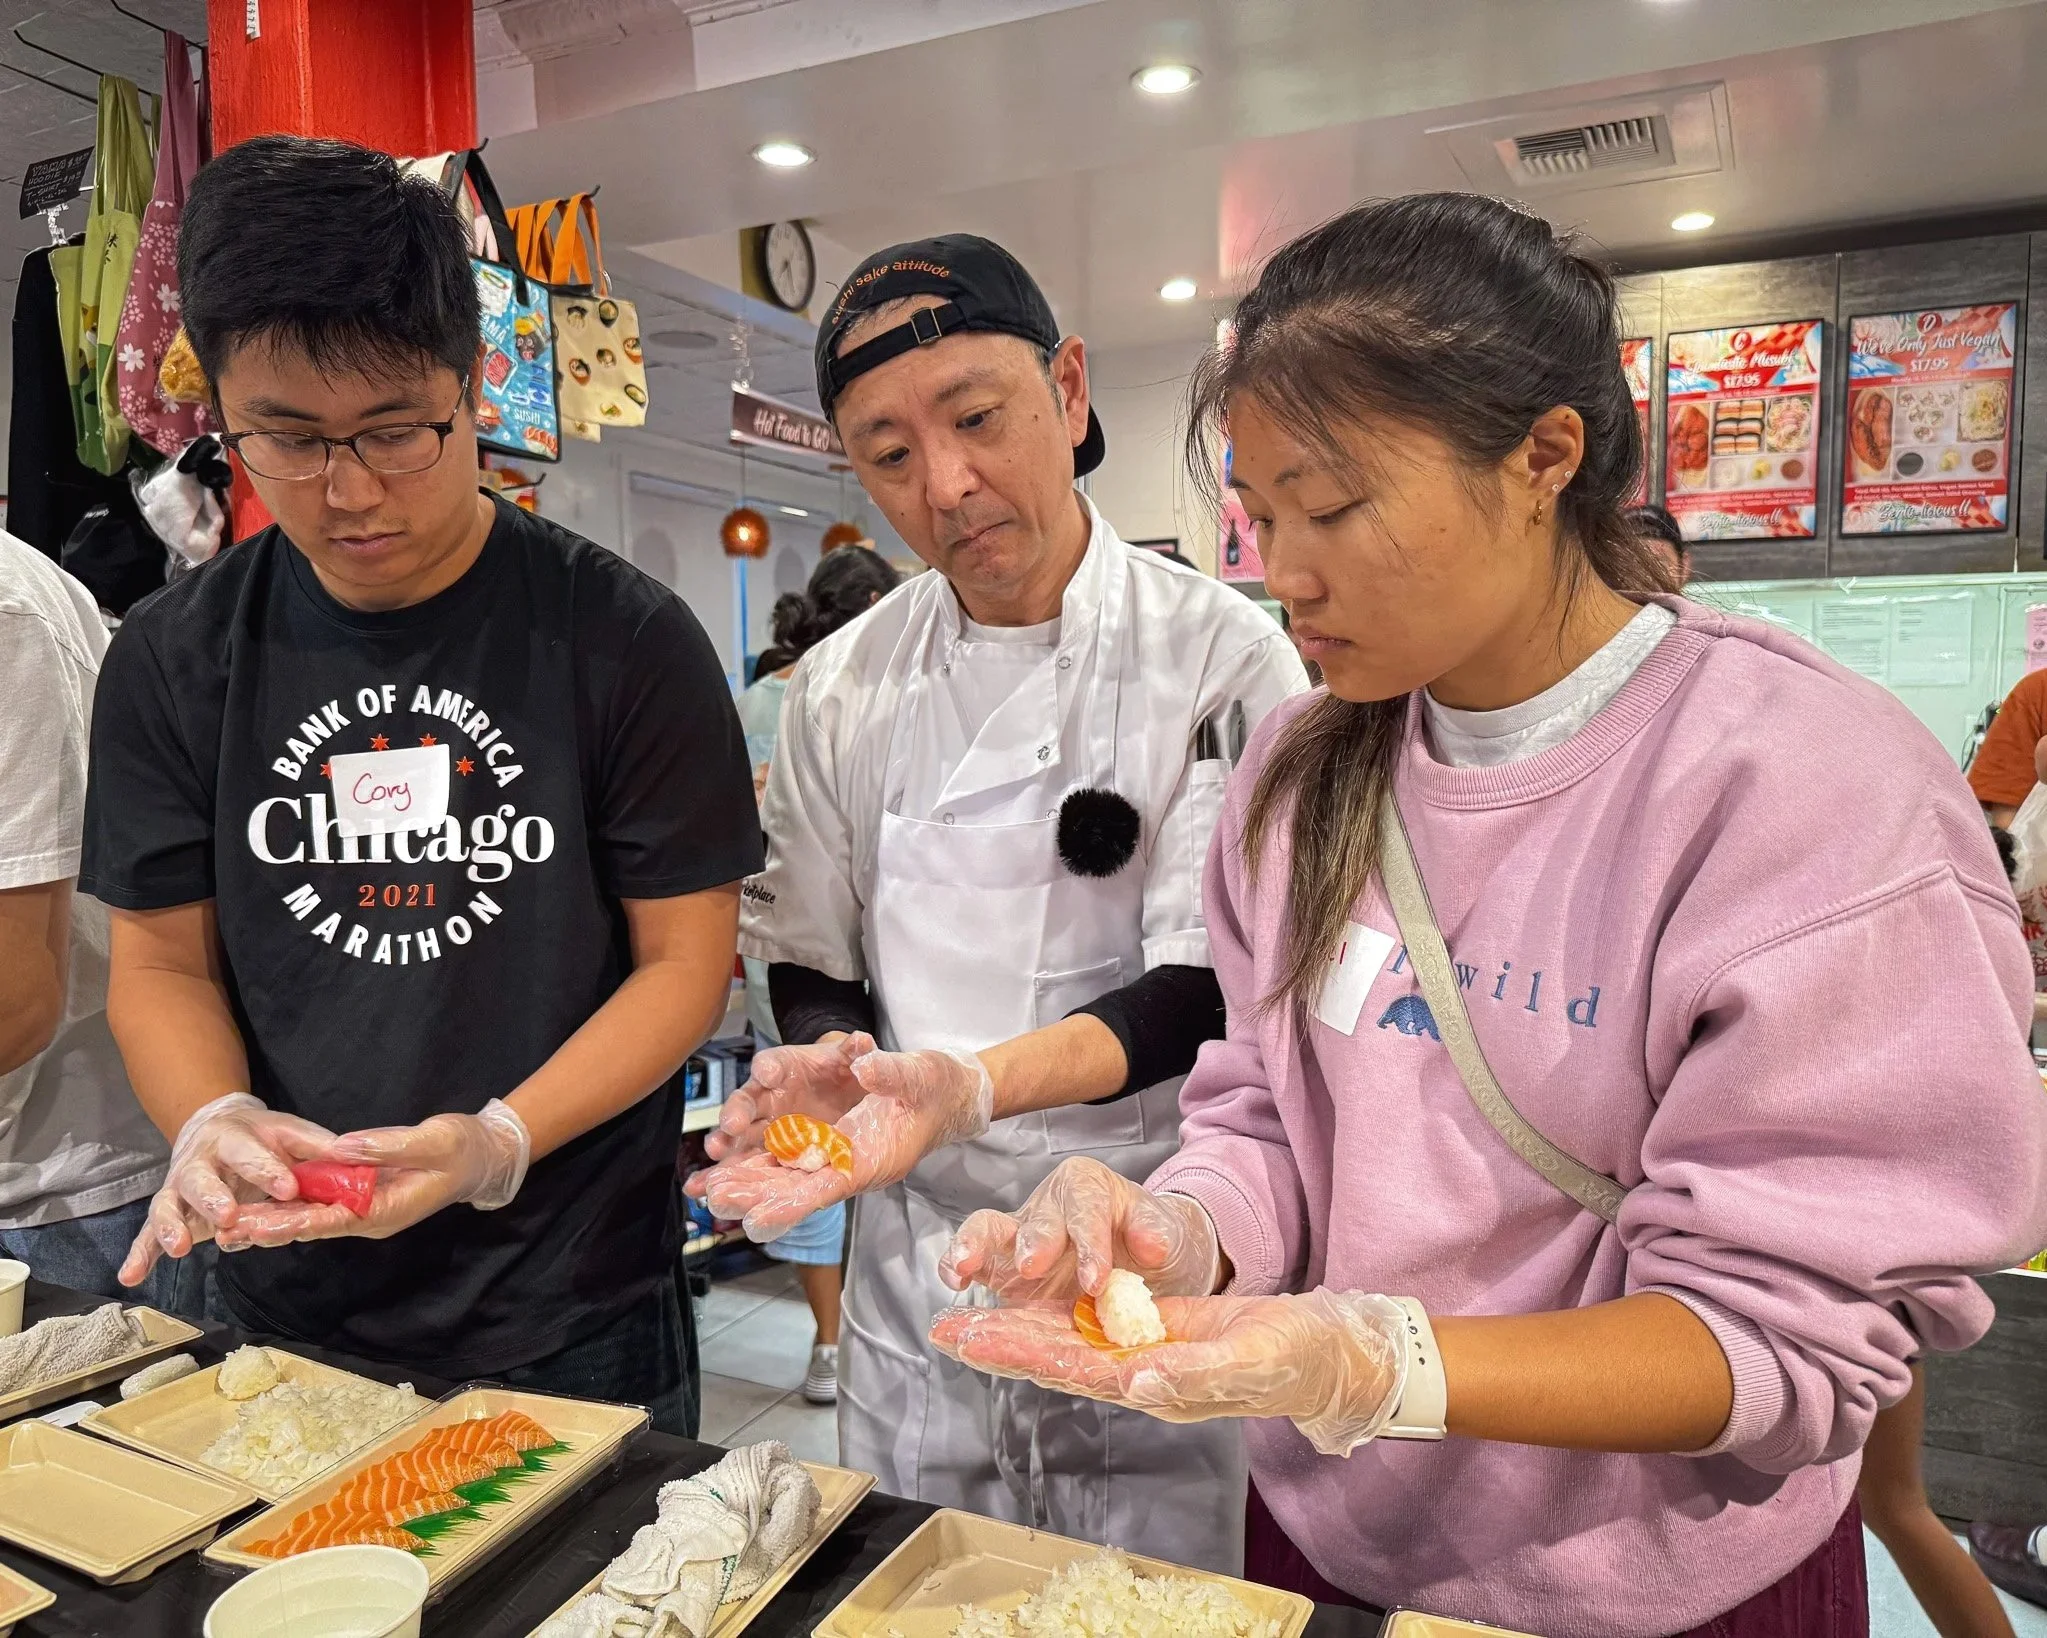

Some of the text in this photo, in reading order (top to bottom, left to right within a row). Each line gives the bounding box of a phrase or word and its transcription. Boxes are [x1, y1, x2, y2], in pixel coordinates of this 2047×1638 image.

[856, 265, 889, 286] sake
[893, 260, 950, 278] attitude
[1857, 328, 2001, 357] We've Only Just Vegan
[753, 407, 776, 437] Hot
[774, 412, 802, 444] Food
[272, 685, 524, 787] BANK OF AMERICA
[353, 773, 411, 811] Cory
[358, 883, 437, 908] 2021
[281, 883, 503, 965] MARATHON
[1452, 961, 1600, 1028] wild
